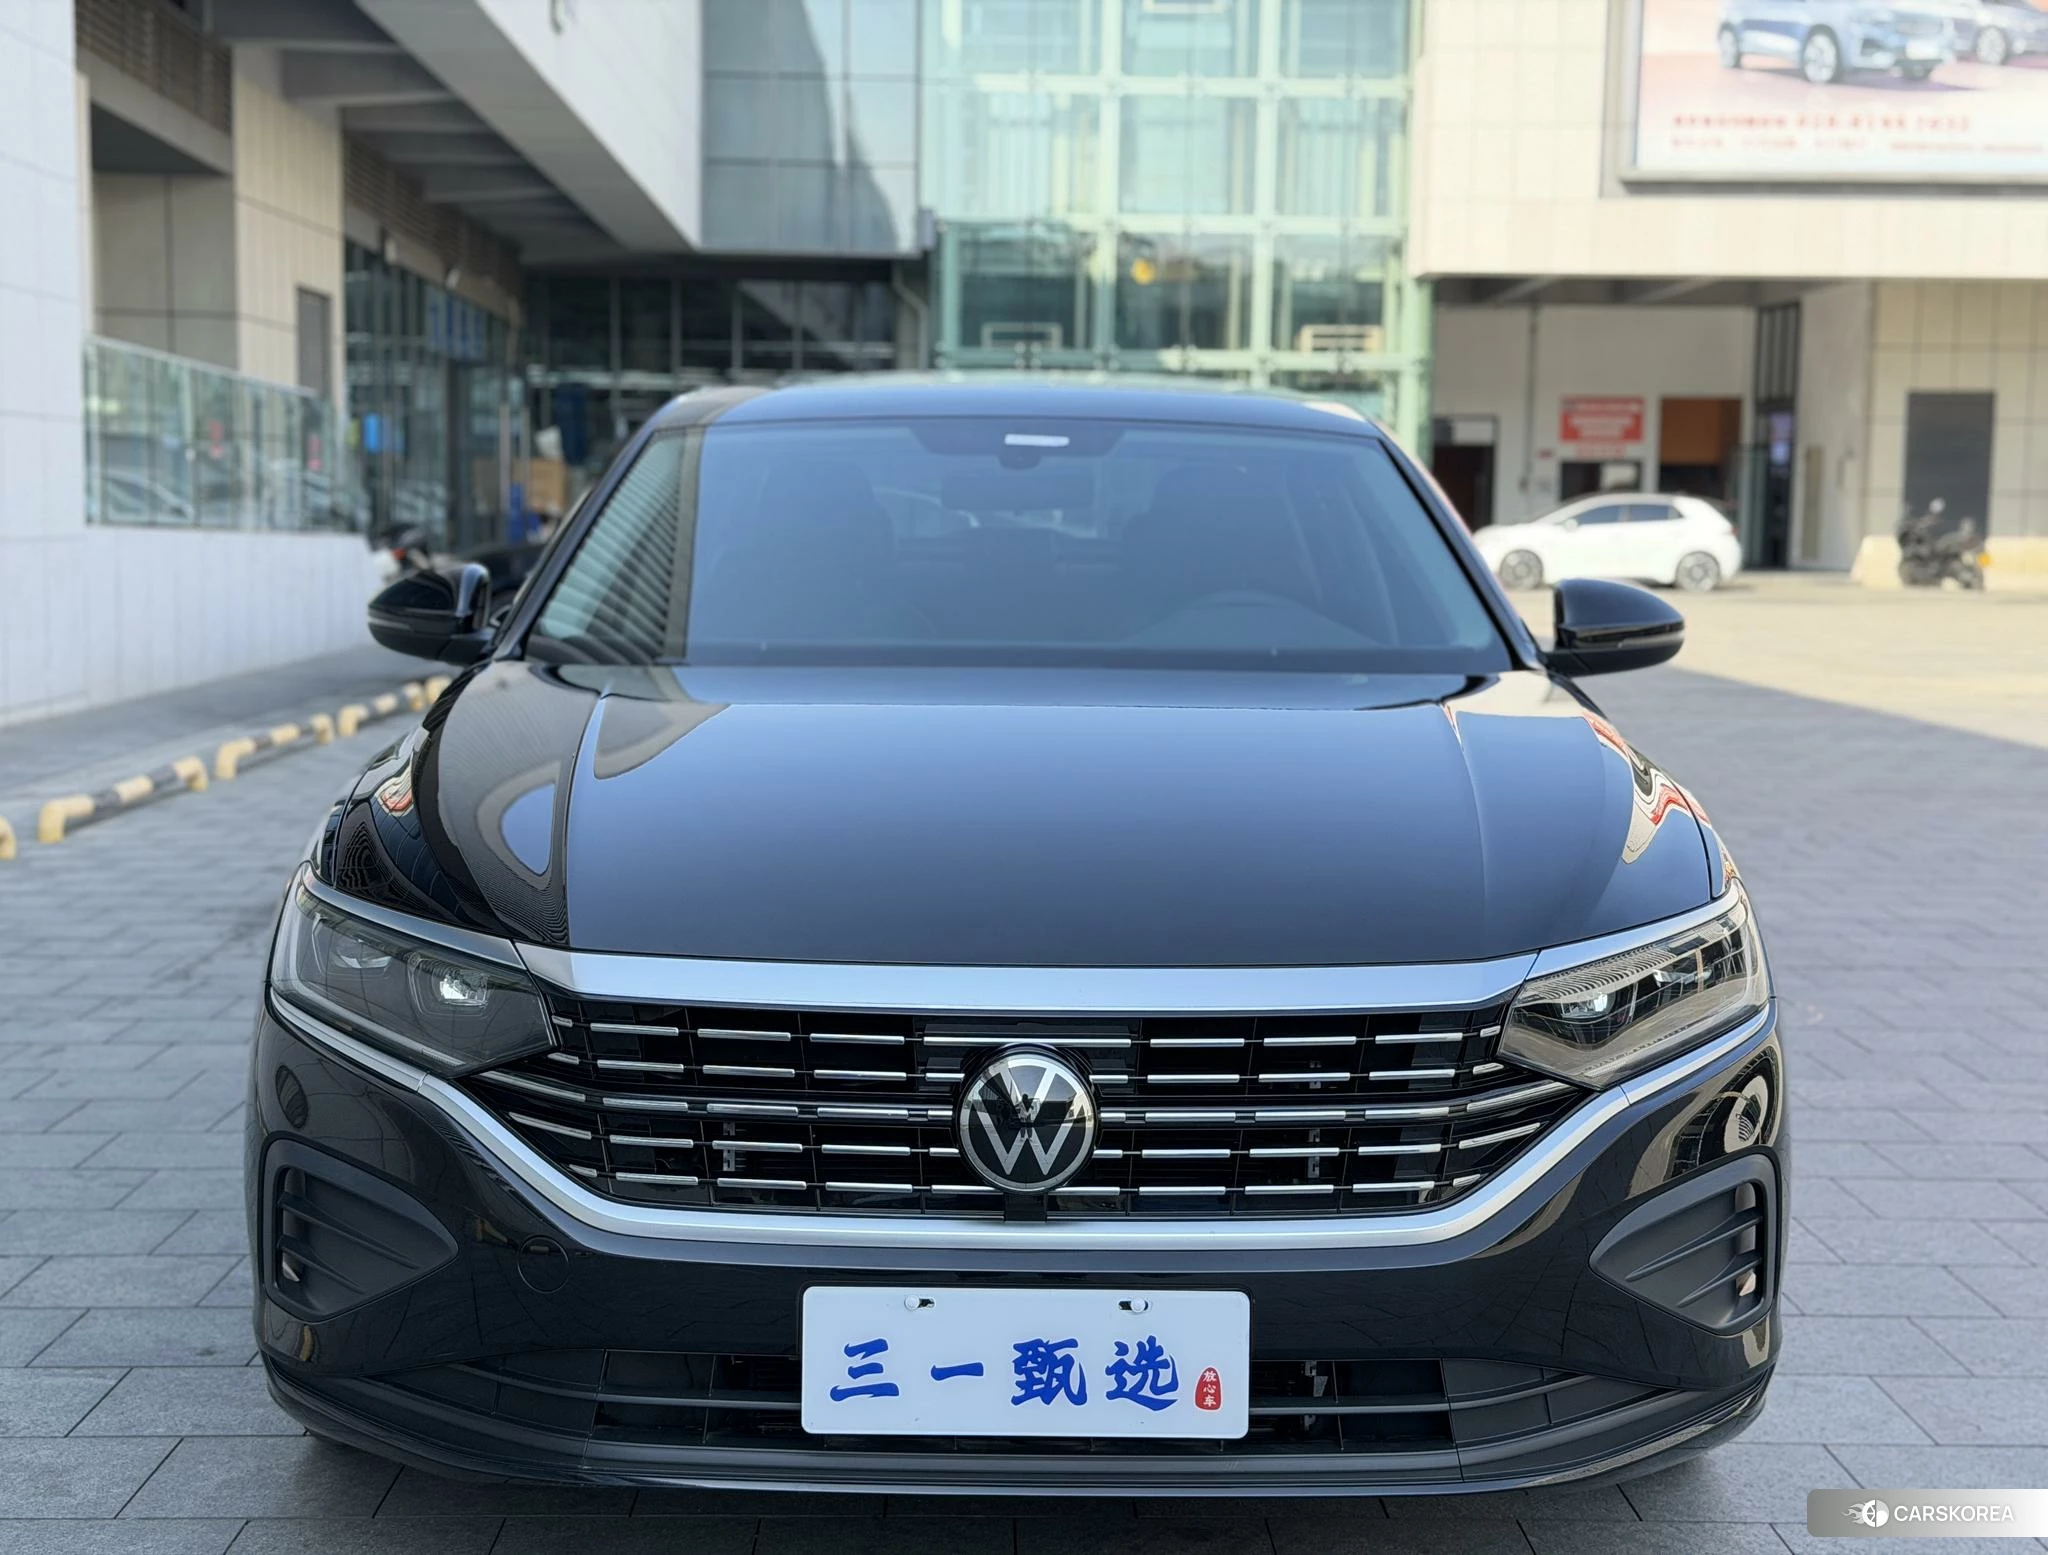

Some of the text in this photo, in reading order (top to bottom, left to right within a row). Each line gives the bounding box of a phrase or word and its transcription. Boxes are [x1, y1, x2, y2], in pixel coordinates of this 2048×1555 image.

[830, 1335, 1179, 1411] 三一甄选
[1203, 1370, 1217, 1407] 放心车
